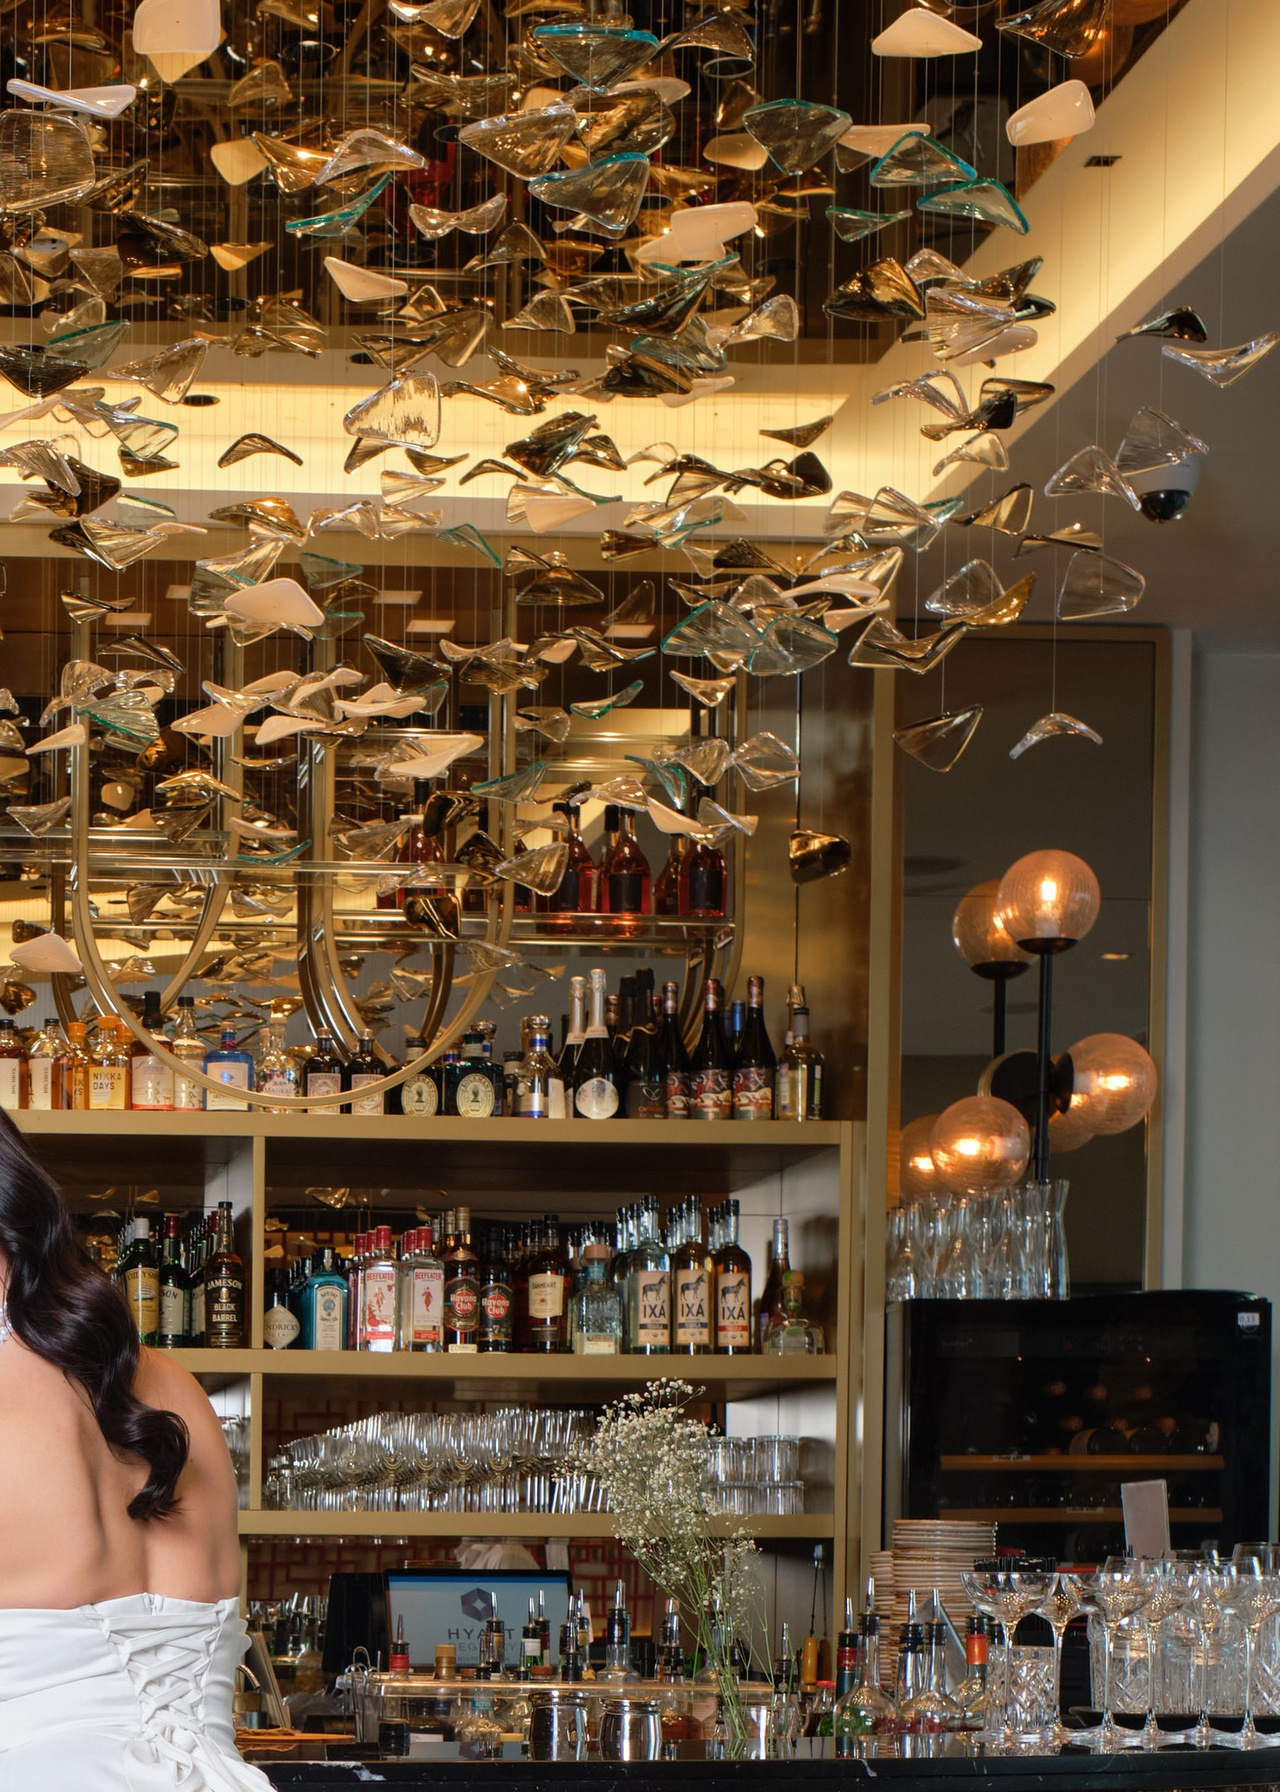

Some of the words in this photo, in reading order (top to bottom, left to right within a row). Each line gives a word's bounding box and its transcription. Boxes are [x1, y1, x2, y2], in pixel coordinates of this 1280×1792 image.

[93, 1072, 122, 1080] NIKKA
[93, 1081, 115, 1090] DAYS
[366, 1272, 395, 1281] BEEFEATER
[415, 1271, 442, 1280] BEEFEATER
[207, 1278, 243, 1291] JAMESON
[450, 1293, 477, 1303] Havana
[481, 1297, 510, 1307] Havana
[213, 1303, 236, 1311] BLACK
[455, 1301, 472, 1311] Club
[487, 1306, 505, 1315] Club
[643, 1300, 666, 1319] IXÁ
[681, 1299, 705, 1317] IXÁ
[721, 1301, 746, 1321] IXÁ
[212, 1314, 238, 1322] BARREL
[447, 1628, 515, 1640] HYAT
